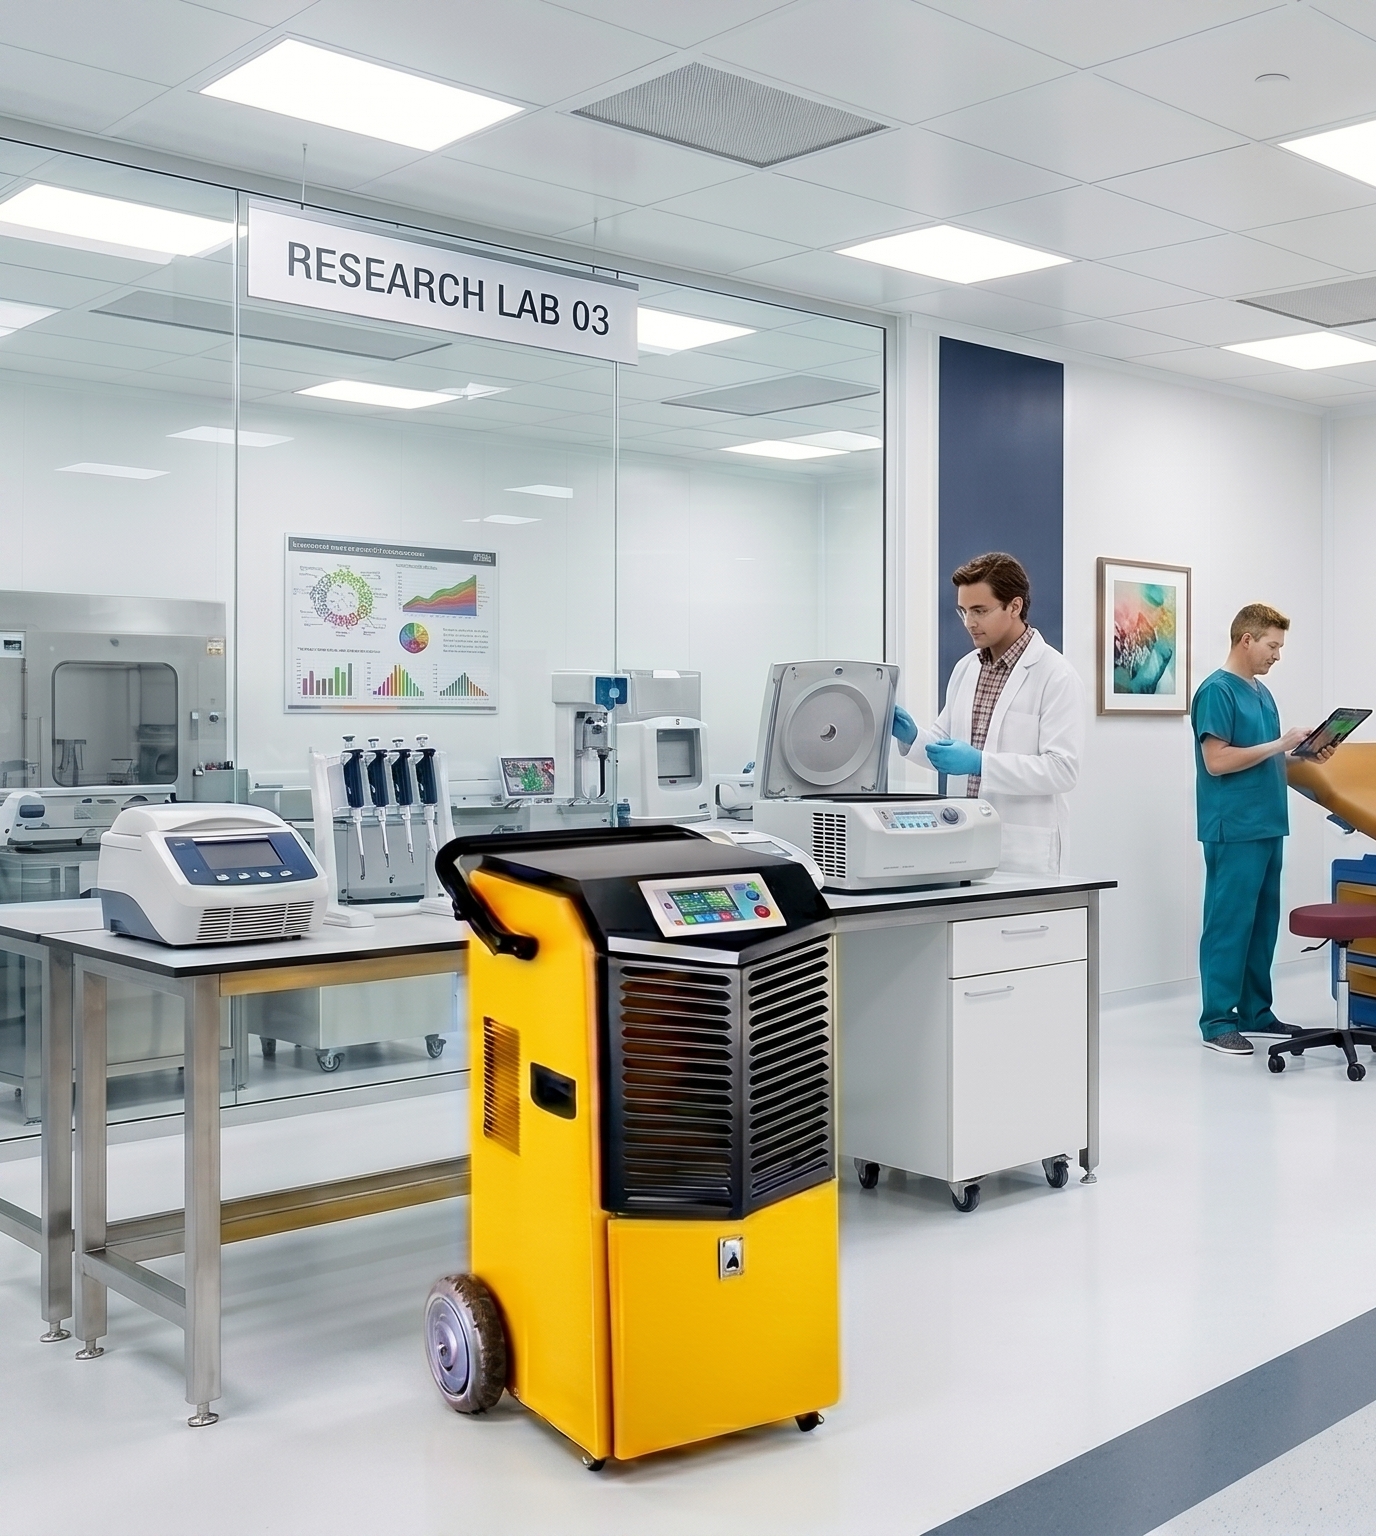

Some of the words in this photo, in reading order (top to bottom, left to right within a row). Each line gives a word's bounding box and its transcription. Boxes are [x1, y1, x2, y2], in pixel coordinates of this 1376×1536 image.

[287, 241, 485, 312] RESEARCH
[498, 283, 560, 326] LAB
[572, 300, 610, 336] 03
